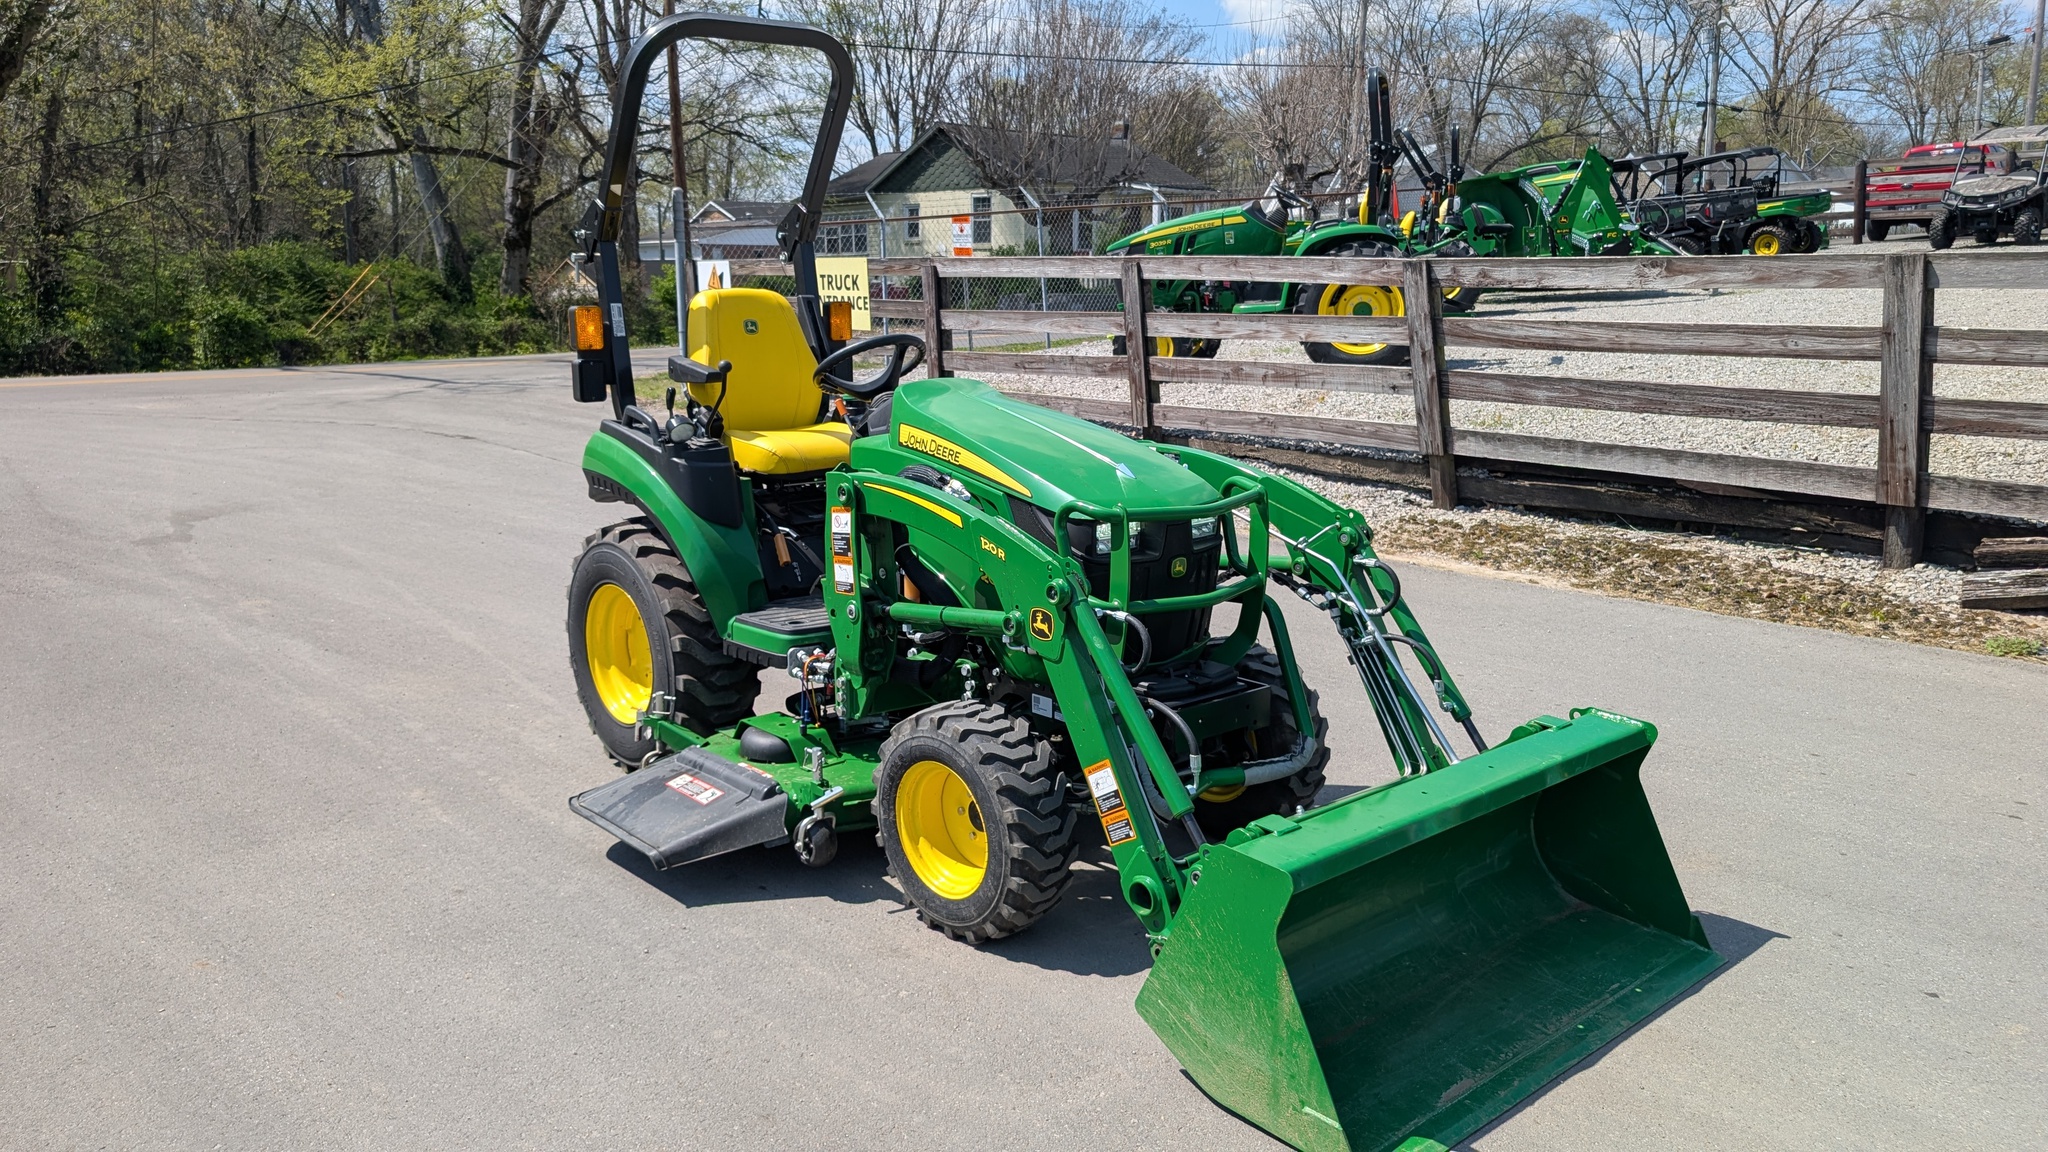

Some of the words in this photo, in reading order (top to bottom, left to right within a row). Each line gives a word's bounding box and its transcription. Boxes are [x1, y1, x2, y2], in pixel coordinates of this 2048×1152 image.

[1176, 225, 1193, 233] JOHN
[1194, 222, 1215, 230] DEERE
[819, 274, 860, 291] TRUCK
[904, 431, 928, 451] JOHN
[929, 439, 961, 463] DEERE
